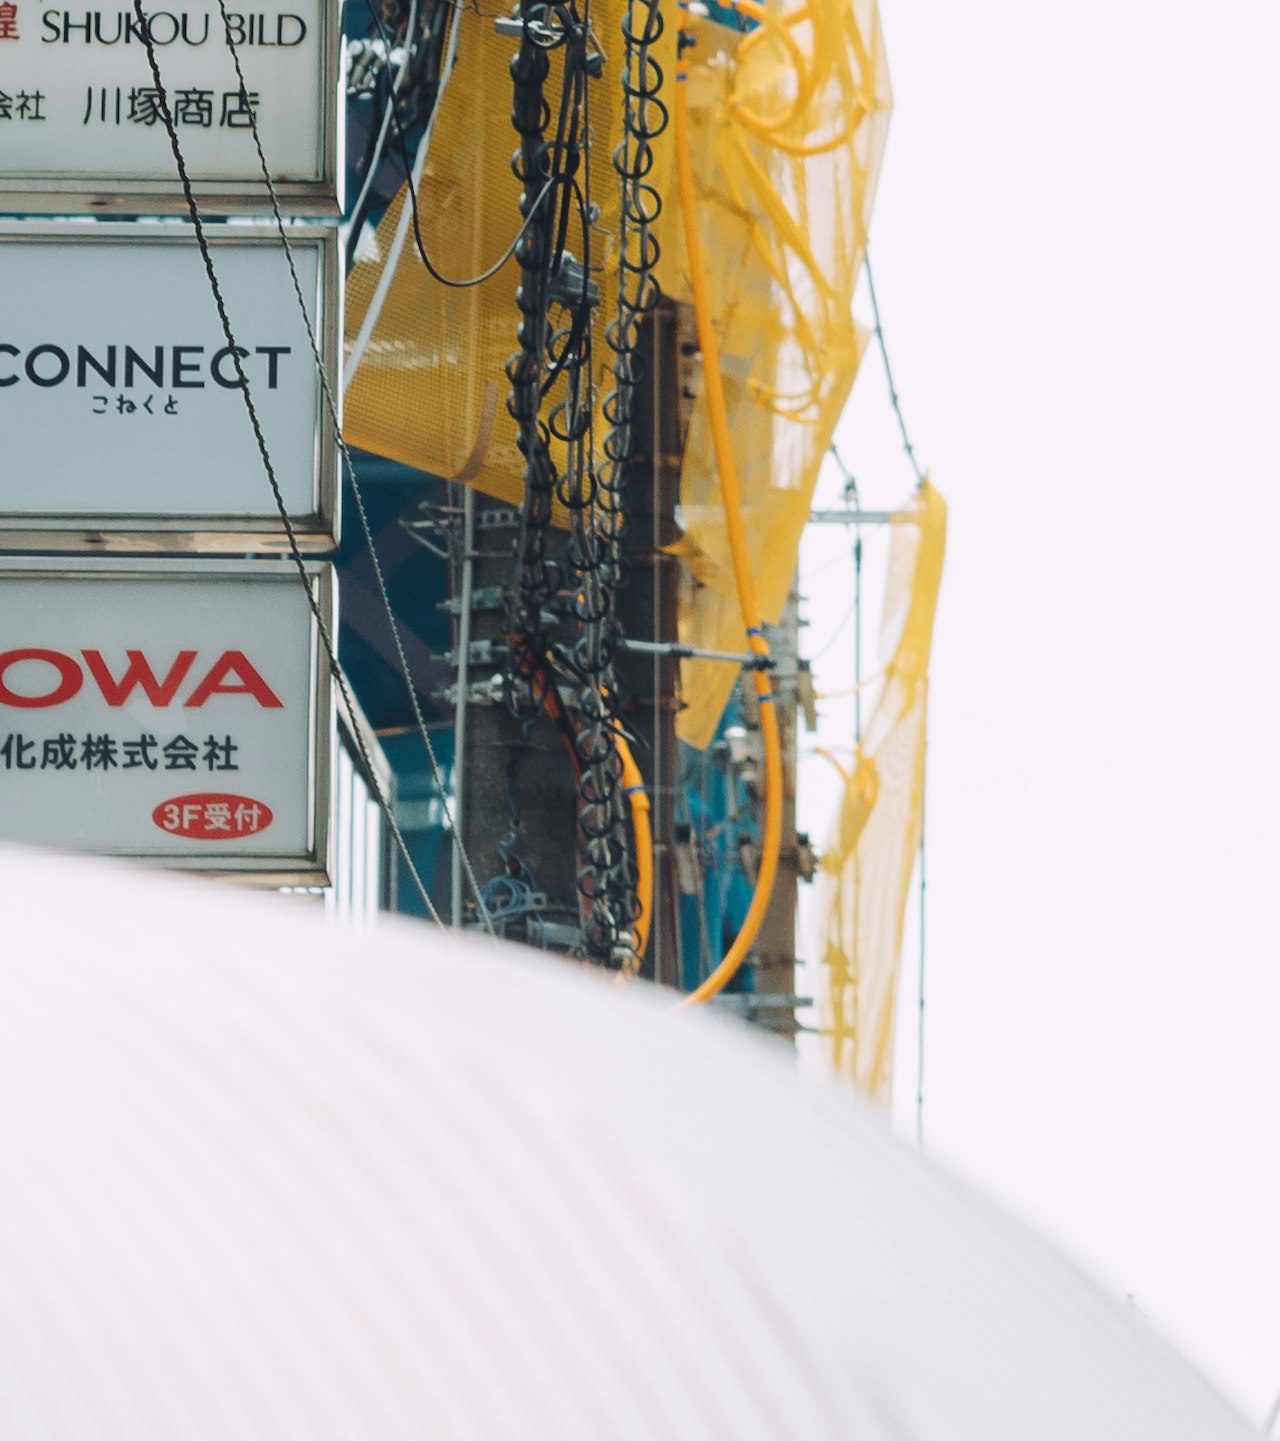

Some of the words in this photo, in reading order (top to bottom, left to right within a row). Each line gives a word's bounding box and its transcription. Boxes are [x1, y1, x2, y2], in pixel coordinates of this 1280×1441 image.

[41, 9, 209, 45] SHUKOU
[225, 13, 307, 46] BILD
[83, 86, 260, 128] 川塚商店
[92, 393, 179, 415] こねくと
[0, 648, 284, 709] OWA
[0, 733, 239, 771] 化成株式会社
[163, 803, 262, 831] 3F受付
